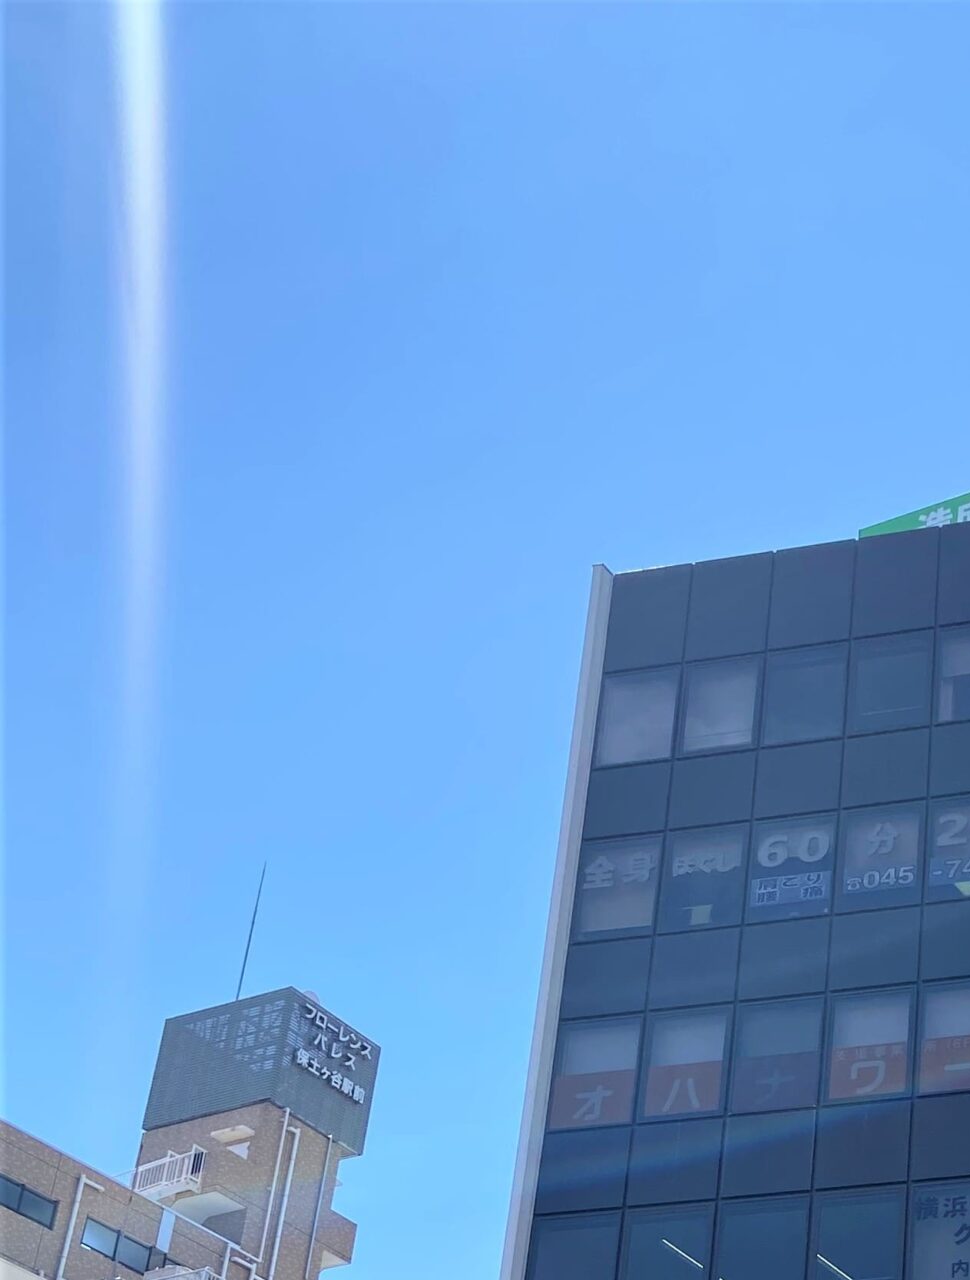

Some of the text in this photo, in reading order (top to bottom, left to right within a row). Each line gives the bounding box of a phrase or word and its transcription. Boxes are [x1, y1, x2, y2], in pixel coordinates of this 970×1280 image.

[305, 1002, 372, 1060] フローレンス
[314, 1033, 356, 1072] パレス
[296, 1047, 367, 1106] 保土ヶ谷駅前
